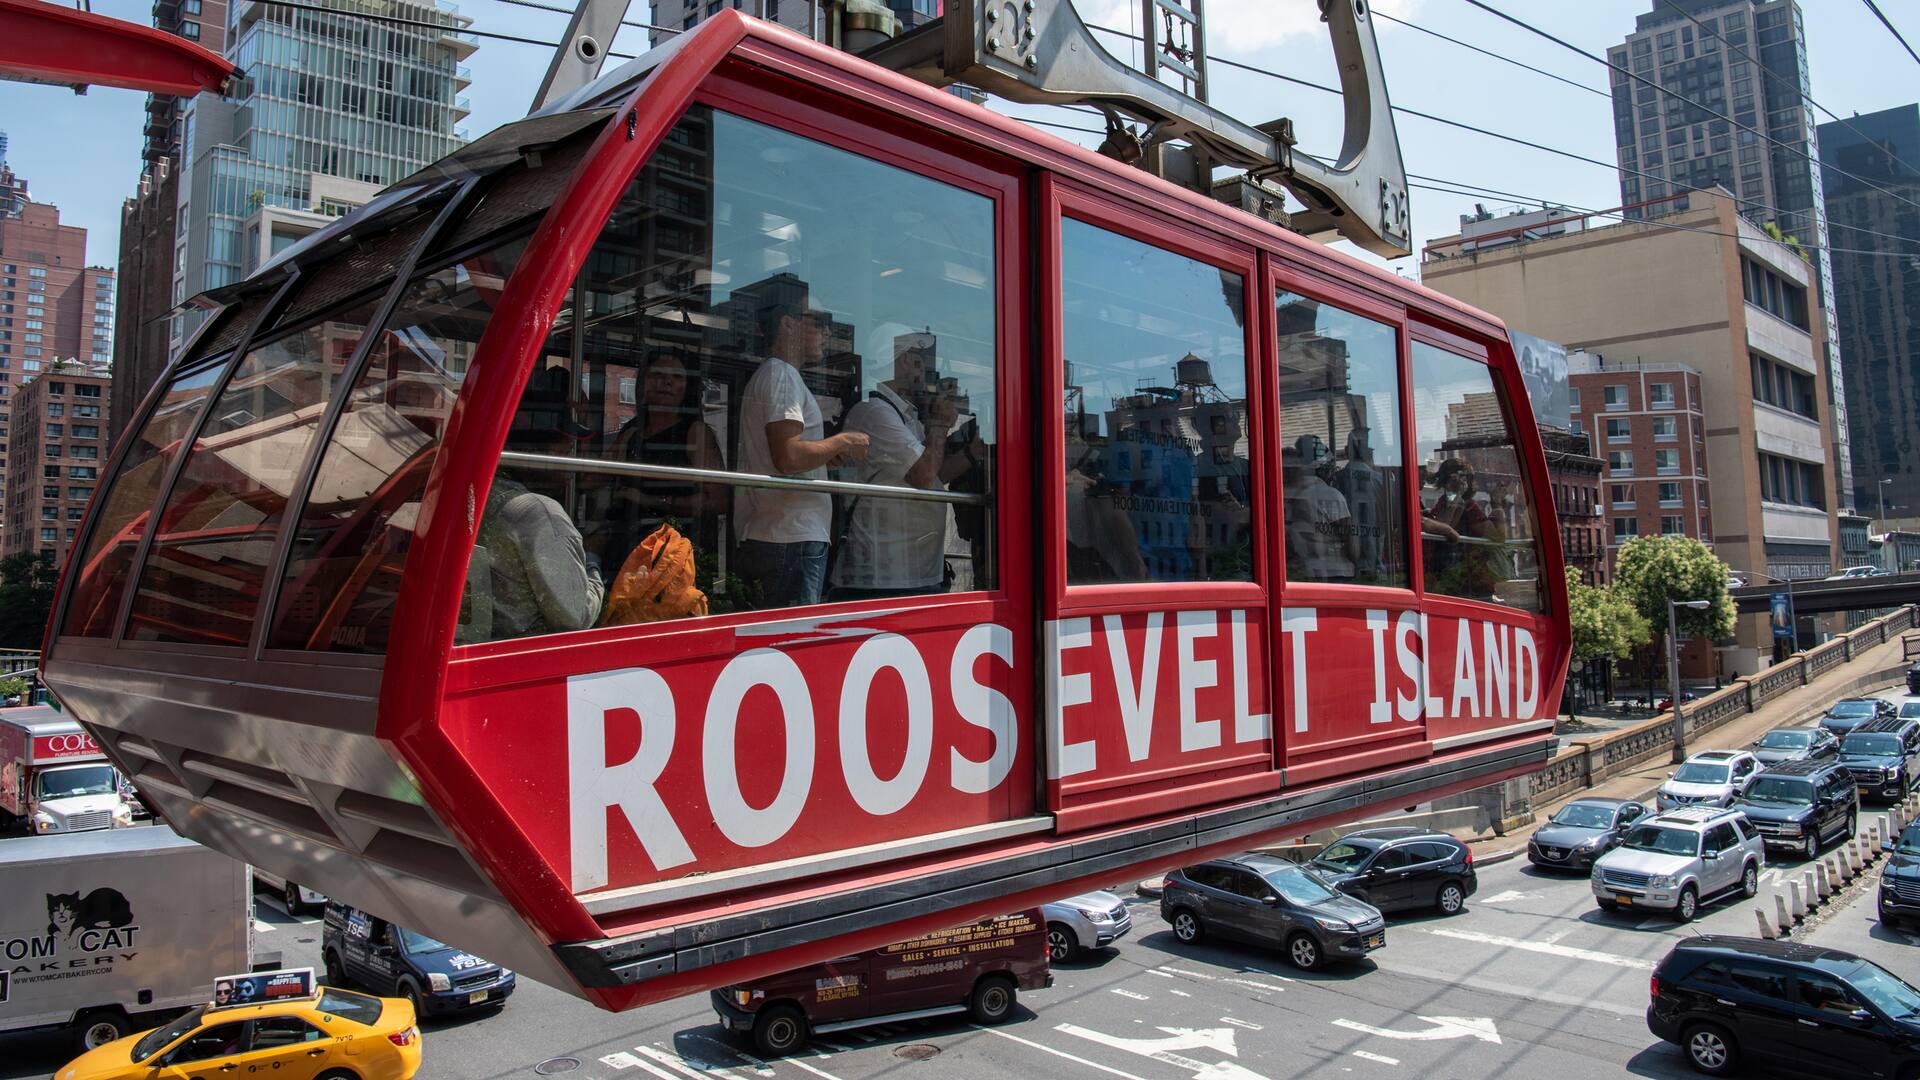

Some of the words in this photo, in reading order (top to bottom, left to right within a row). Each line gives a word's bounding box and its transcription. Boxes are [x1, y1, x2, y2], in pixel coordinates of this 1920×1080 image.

[49, 734, 99, 752] COR
[567, 608, 1317, 894] ROOSEVELT
[1366, 609, 1540, 725] ISLAND
[347, 920, 364, 938] TSE
[998, 920, 1007, 929] ICE
[1008, 918, 1030, 927] MAKERS
[80, 926, 140, 952] CAT
[902, 952, 924, 962] SALES
[933, 947, 960, 958] SERVICE
[968, 938, 1015, 952] INSTALLATION
[1, 952, 138, 975] AKERY
[456, 958, 487, 970] TSE
[14, 967, 113, 984] WWW.TOMCATBAKERY.COM
[335, 1035, 353, 1043] 7V10
